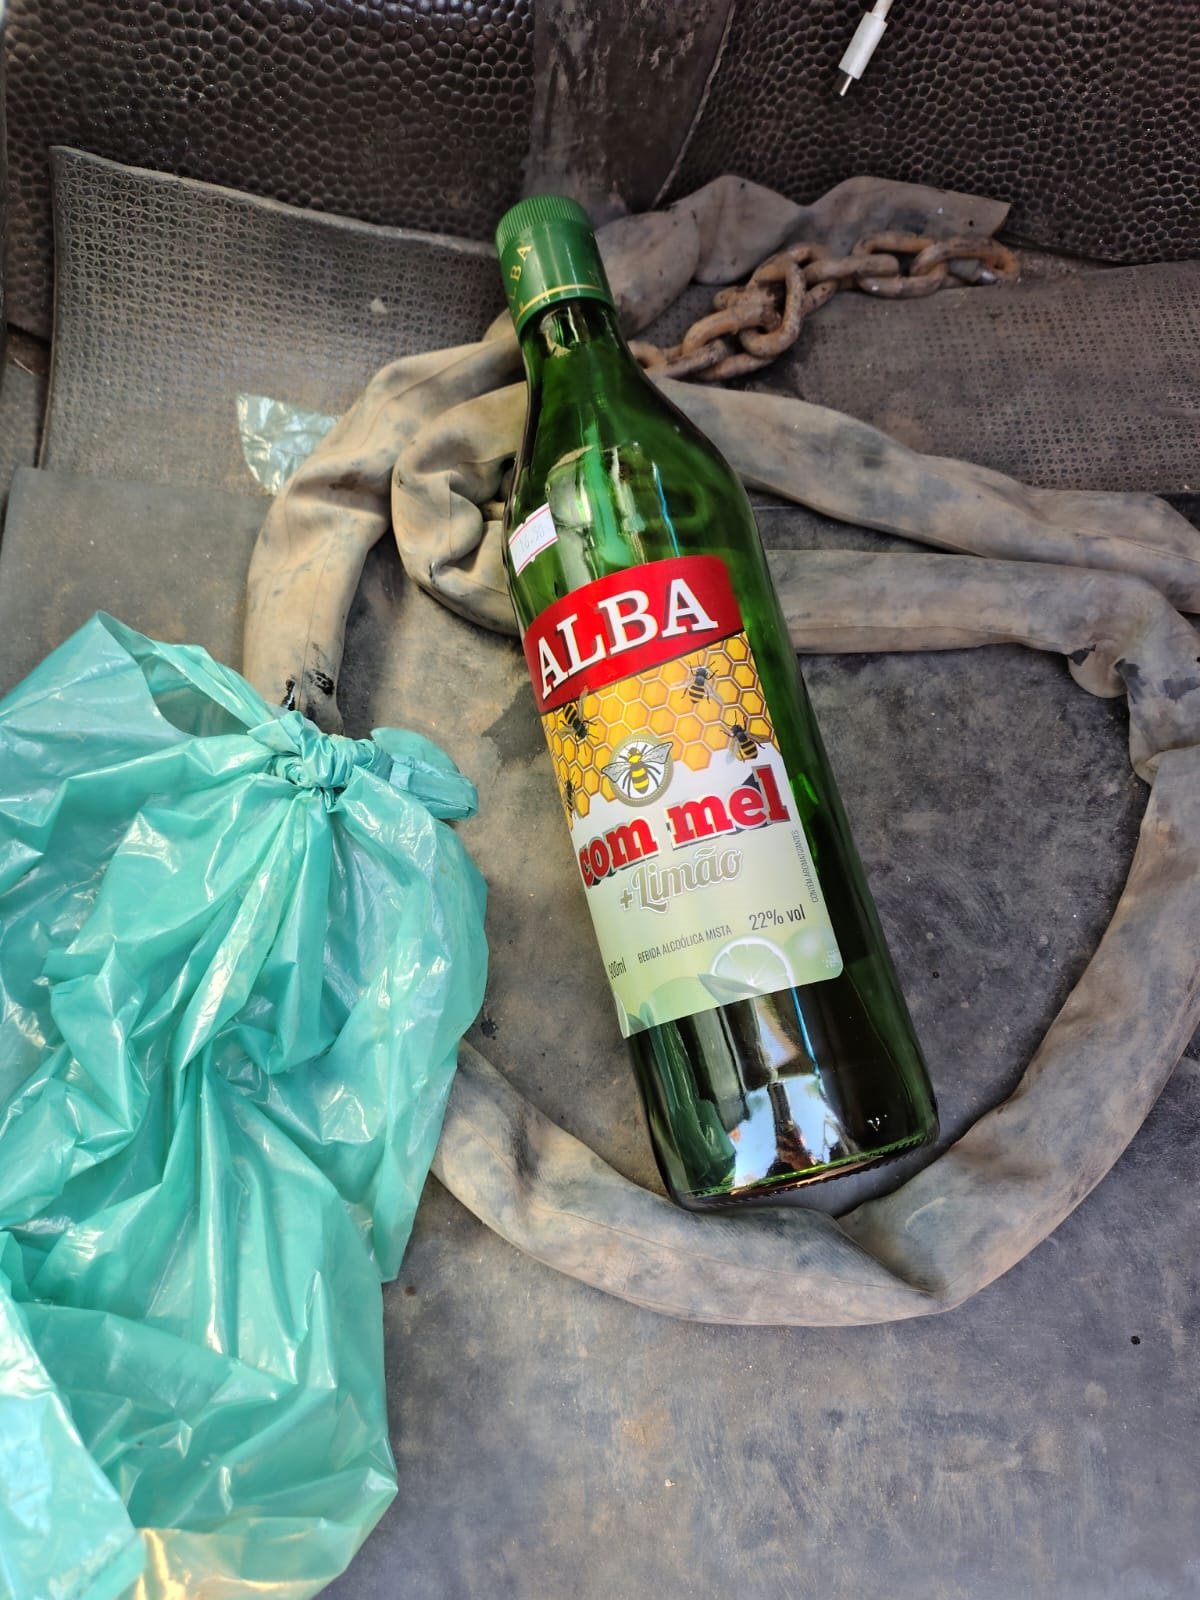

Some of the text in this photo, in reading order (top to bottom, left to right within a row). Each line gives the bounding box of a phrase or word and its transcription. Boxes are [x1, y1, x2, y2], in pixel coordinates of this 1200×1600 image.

[537, 578, 719, 701] ALBA
[578, 765, 791, 888] com mel
[637, 924, 733, 964] BEBIDA ALCOÓLICA MISTA
[748, 903, 806, 931] 22% vol
